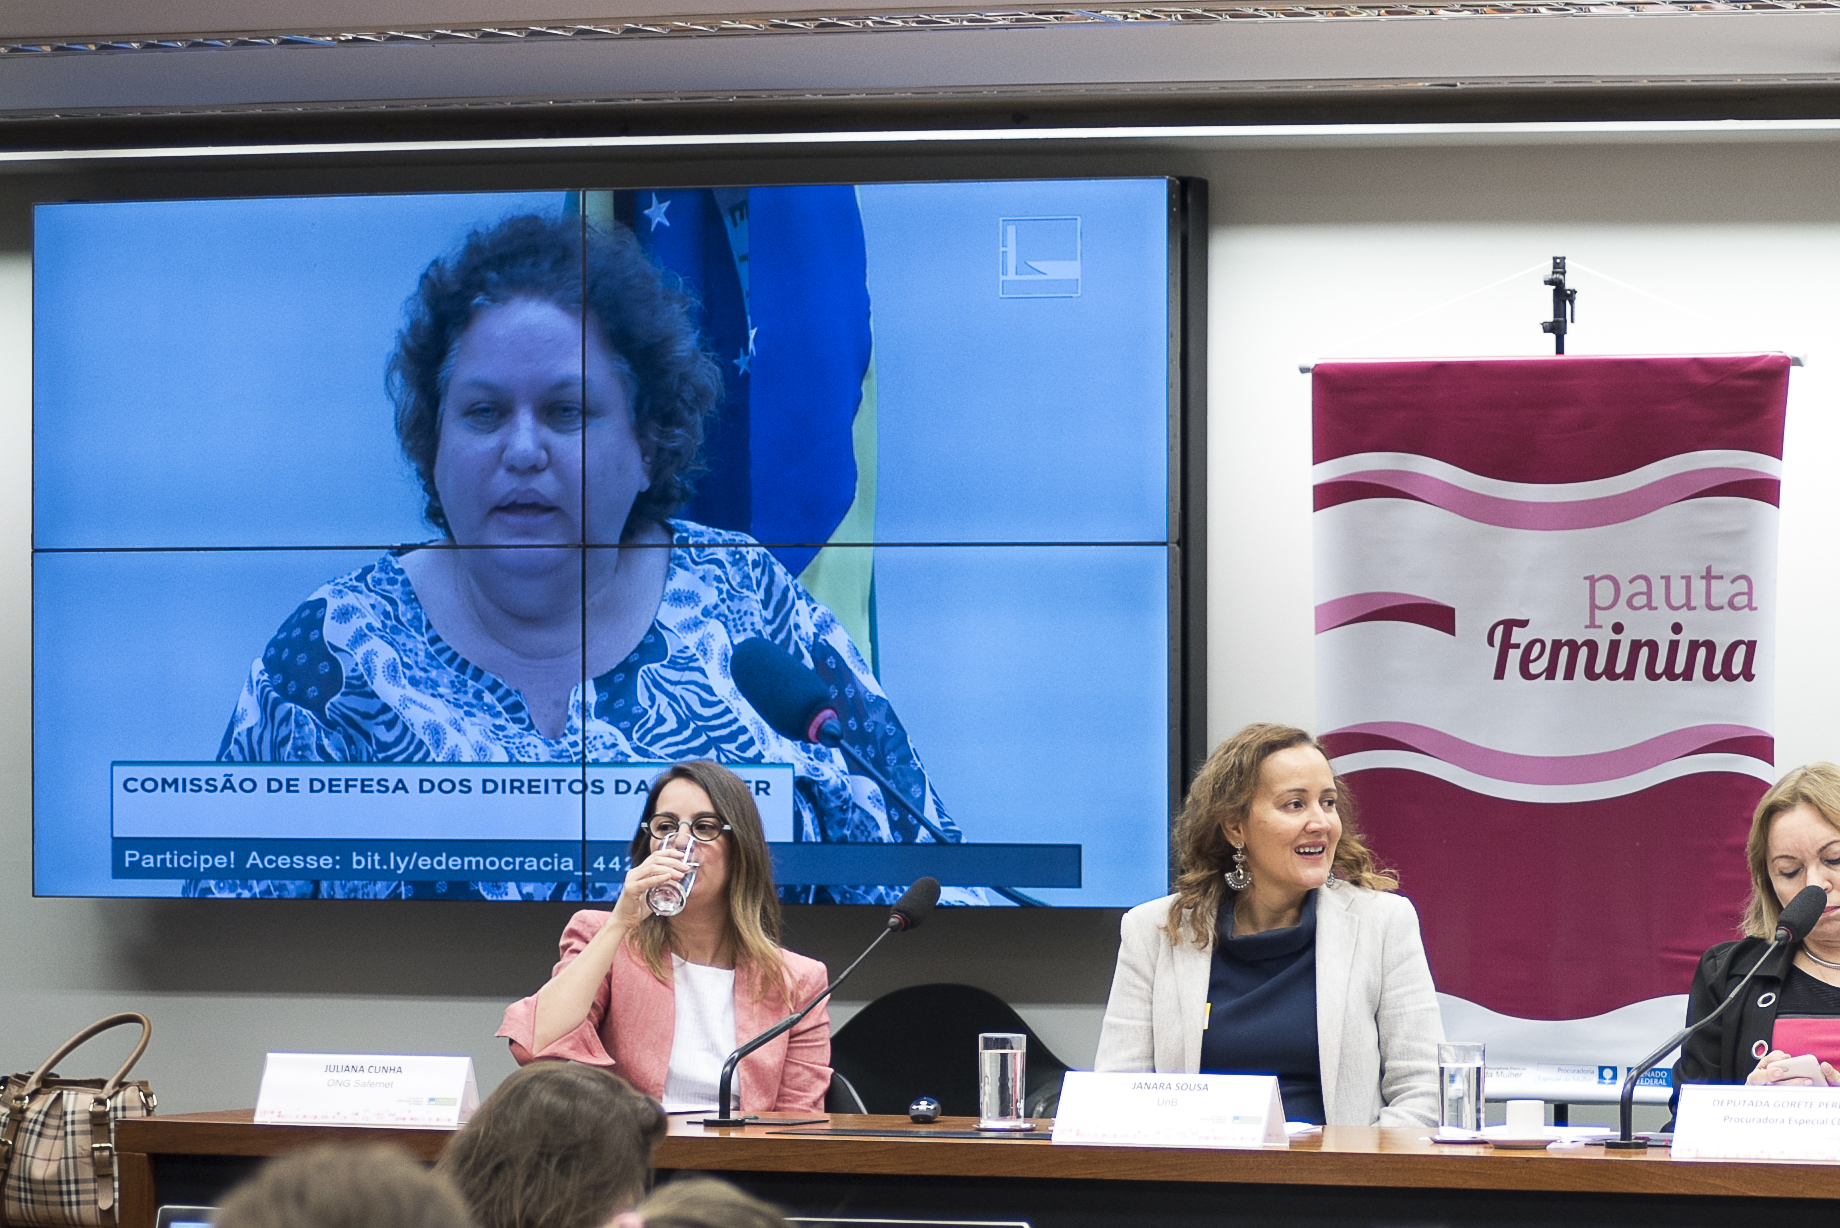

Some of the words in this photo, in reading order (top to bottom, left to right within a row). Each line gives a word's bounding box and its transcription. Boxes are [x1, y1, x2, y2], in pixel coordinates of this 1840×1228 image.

[1583, 564, 1758, 629] pauta
[1486, 618, 1758, 682] Feminina
[122, 773, 258, 795] COMISSÃO
[266, 778, 300, 794] DE
[309, 778, 410, 795] DEFESA
[418, 778, 473, 795] DOS
[481, 778, 605, 796] DIREITOS
[614, 779, 650, 796] DA
[124, 850, 235, 873] Participe!
[246, 851, 341, 871] Acesse:
[324, 1064, 365, 1073] JULIANA
[367, 1065, 403, 1074] CUNHA
[1557, 1067, 1595, 1075] Procuradoria
[326, 1078, 351, 1088] ONG
[353, 1079, 394, 1089] Safernet
[1132, 1081, 1172, 1091] JANARA
[1175, 1082, 1209, 1092] SOUSA
[1157, 1097, 1178, 1107] UnB
[1712, 1099, 1770, 1108] DEPUTADA
[1773, 1100, 1815, 1109] GORETE
[1723, 1115, 1785, 1125] Procuradora
[1788, 1116, 1828, 1127] Especial
